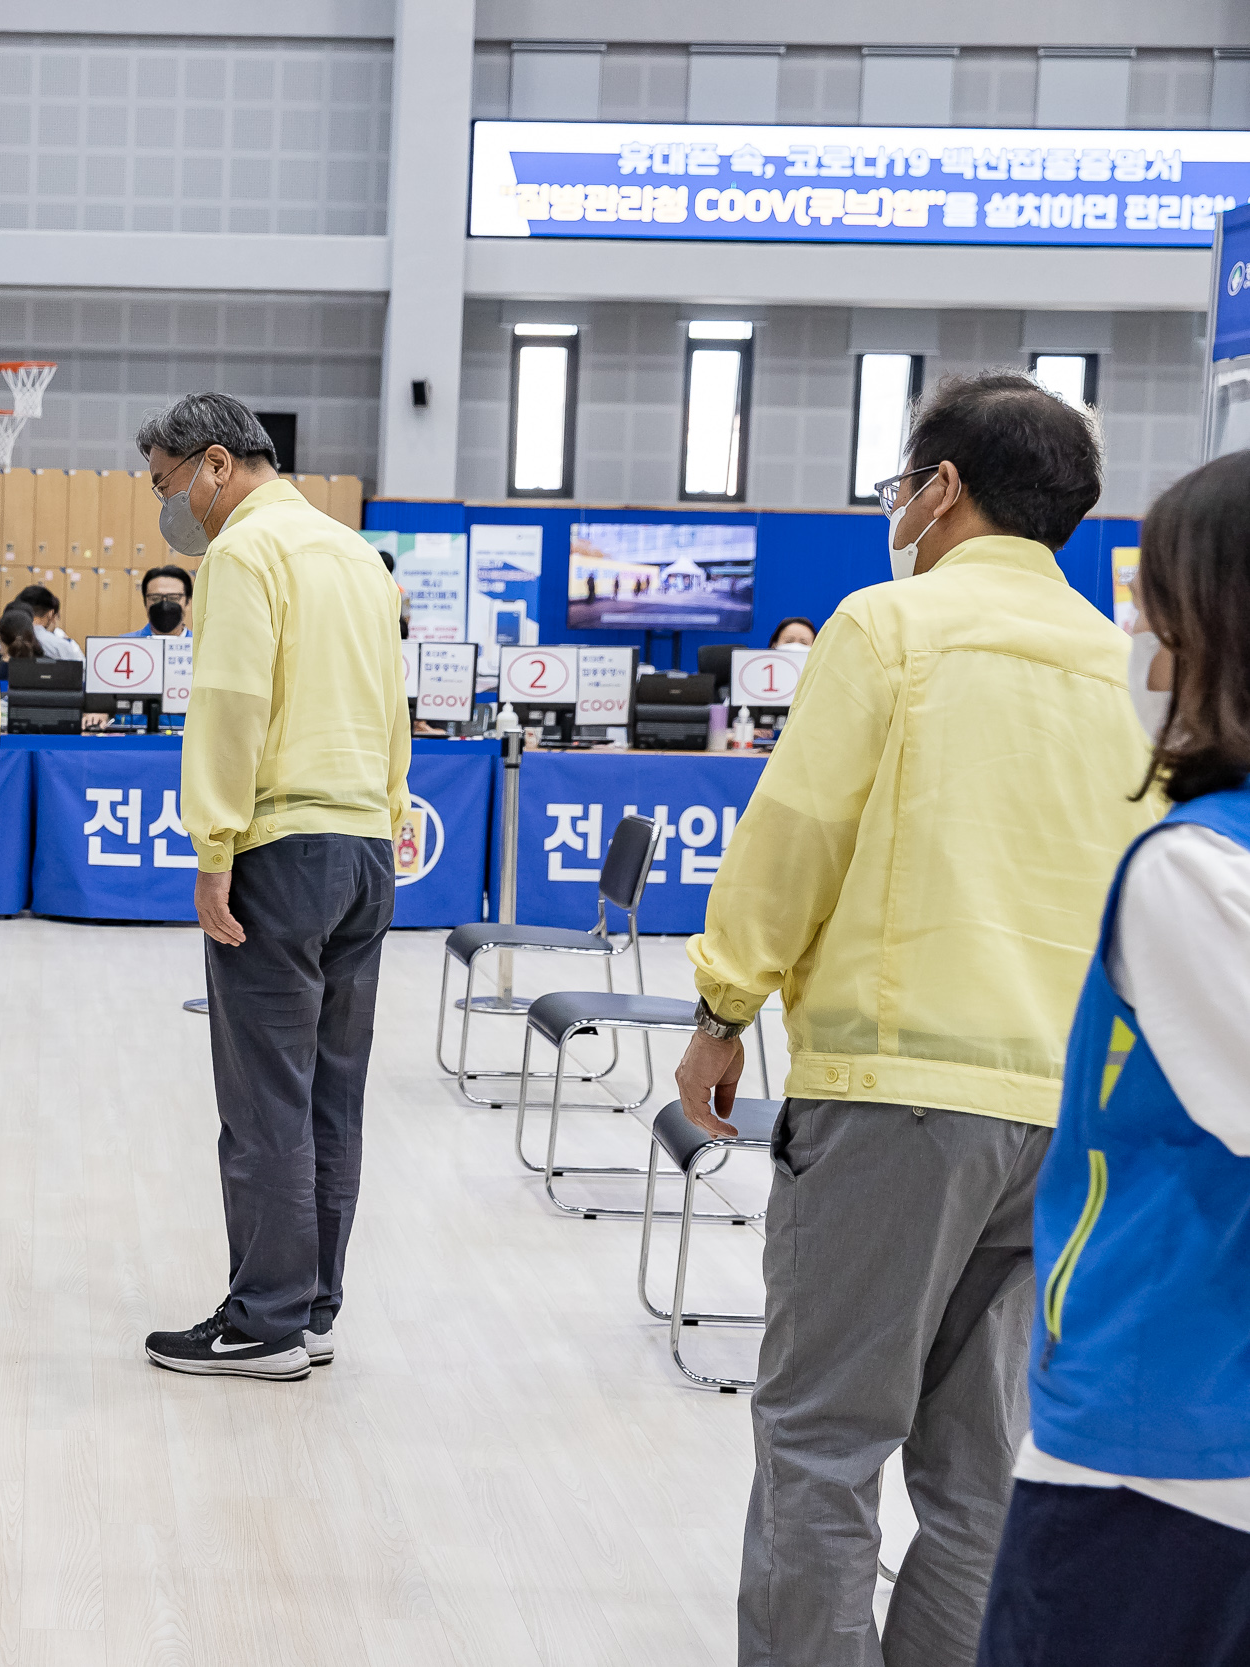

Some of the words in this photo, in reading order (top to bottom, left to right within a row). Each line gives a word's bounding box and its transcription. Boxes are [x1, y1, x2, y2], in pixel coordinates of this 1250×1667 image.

[618, 141, 721, 176] 휴대폰
[784, 144, 931, 179] 코로나19
[941, 147, 1182, 182] 백신접종증명서
[985, 192, 1118, 230] 설치하면
[113, 651, 134, 680] 4
[529, 660, 548, 689] 2
[762, 664, 779, 692] 1
[421, 694, 469, 707] COOV
[580, 699, 627, 712] COOV
